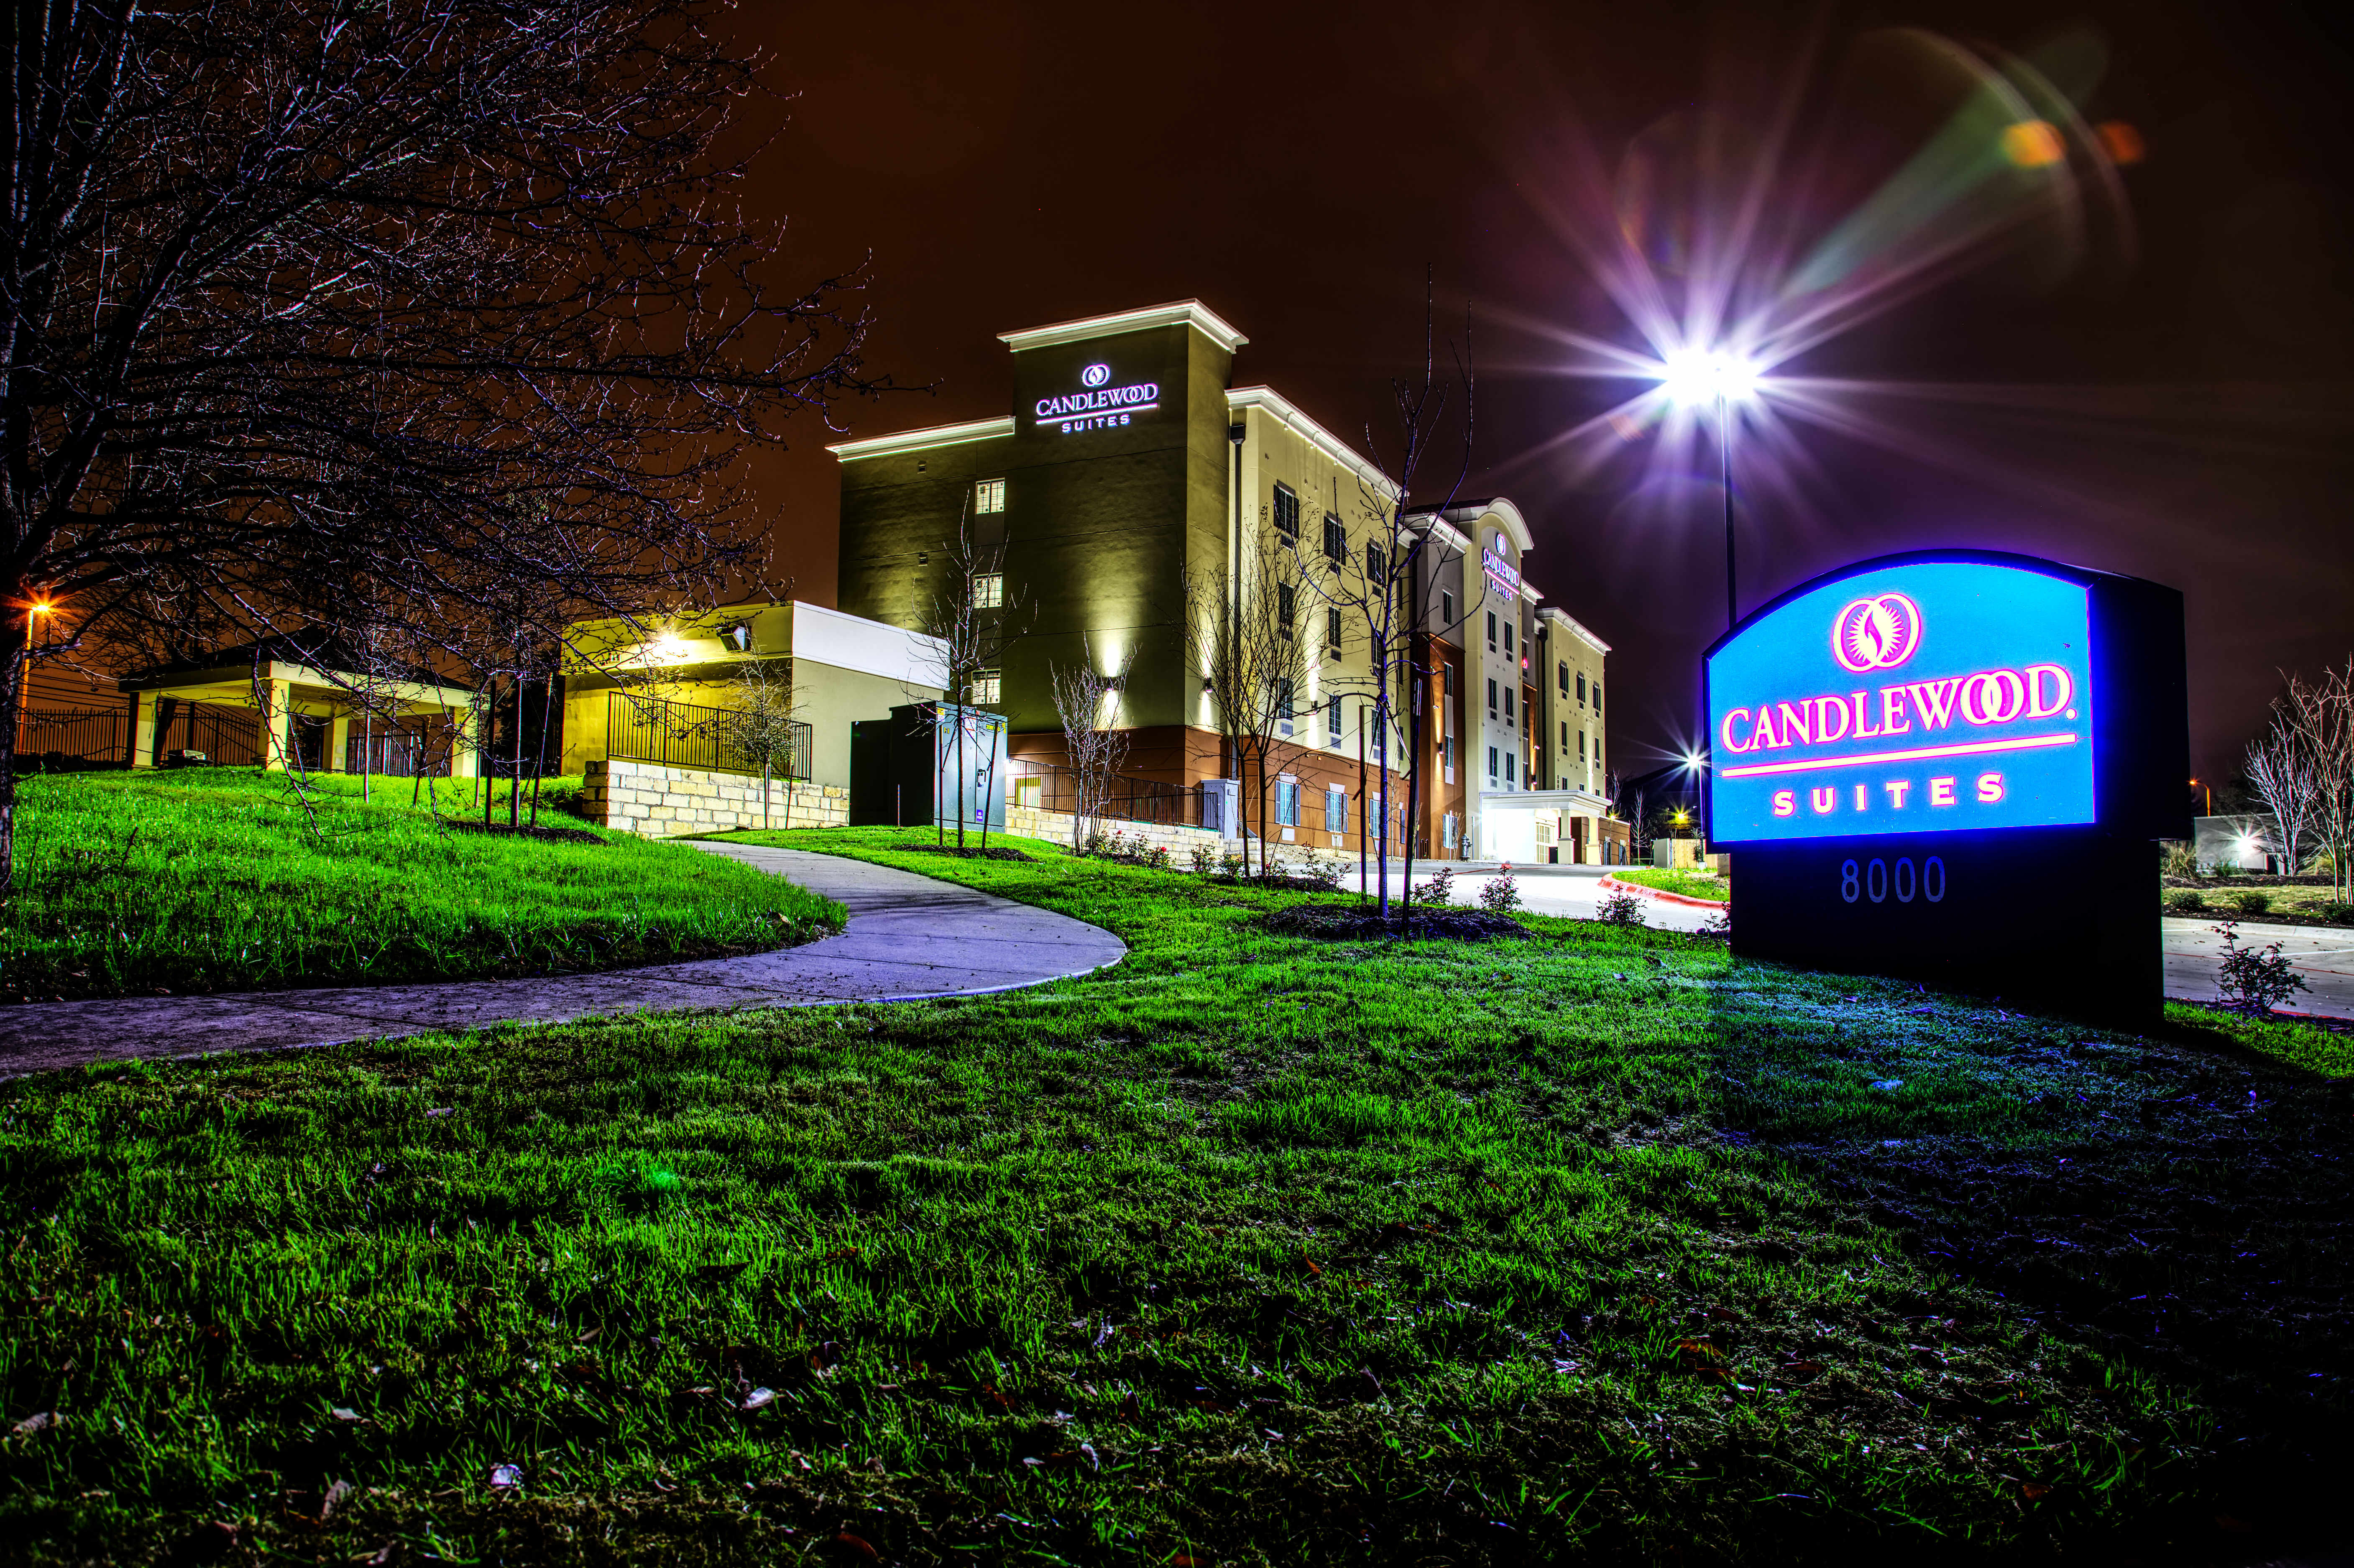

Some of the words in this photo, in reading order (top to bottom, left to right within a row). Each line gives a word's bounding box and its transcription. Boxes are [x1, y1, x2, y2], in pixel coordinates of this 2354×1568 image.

[1036, 383, 1158, 416] CANDLEWOOD
[1061, 414, 1130, 433] SUITES
[1483, 548, 1520, 587] CANDLEWOOD
[1491, 580, 1513, 601] SUITES
[1773, 773, 2004, 817] SUITES
[1841, 855, 1946, 903] 8000
